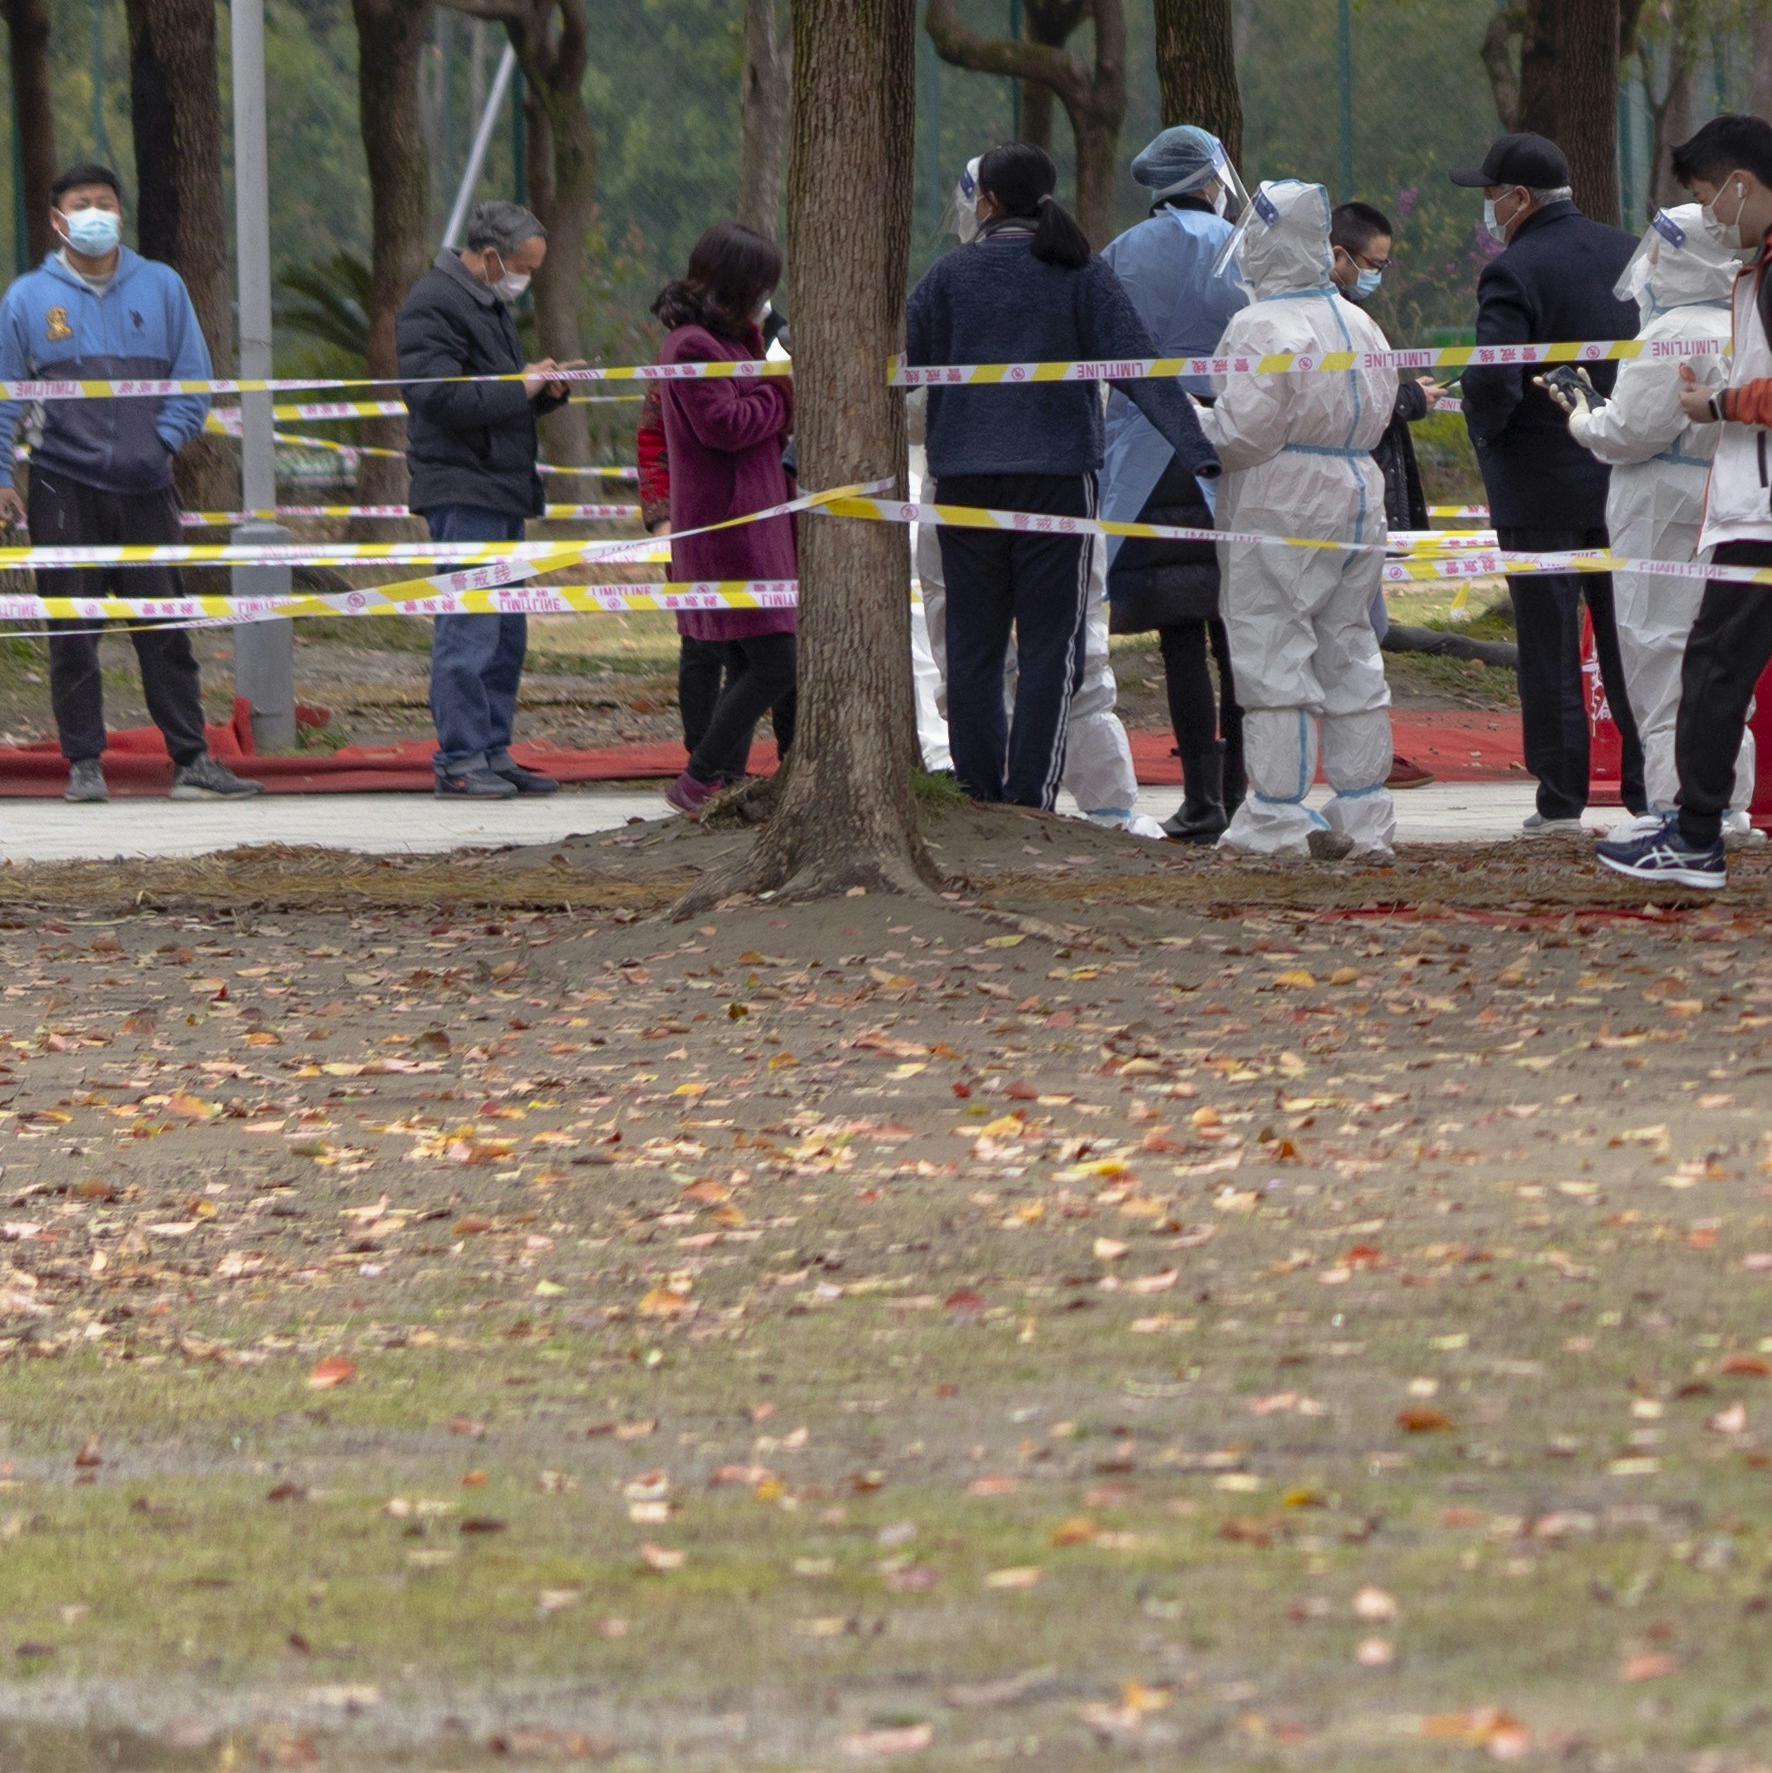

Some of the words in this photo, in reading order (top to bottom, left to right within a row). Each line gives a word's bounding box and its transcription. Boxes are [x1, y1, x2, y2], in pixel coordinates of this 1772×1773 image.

[1479, 346, 1537, 363] 警戒线
[1652, 340, 1720, 357] LIMITLINE
[1192, 358, 1250, 374] 警戒线
[1365, 351, 1431, 368] LIMITLINE
[904, 368, 962, 384] 警戒线
[1077, 362, 1144, 379] LIMITLINE
[451, 563, 513, 592] 警戒线
